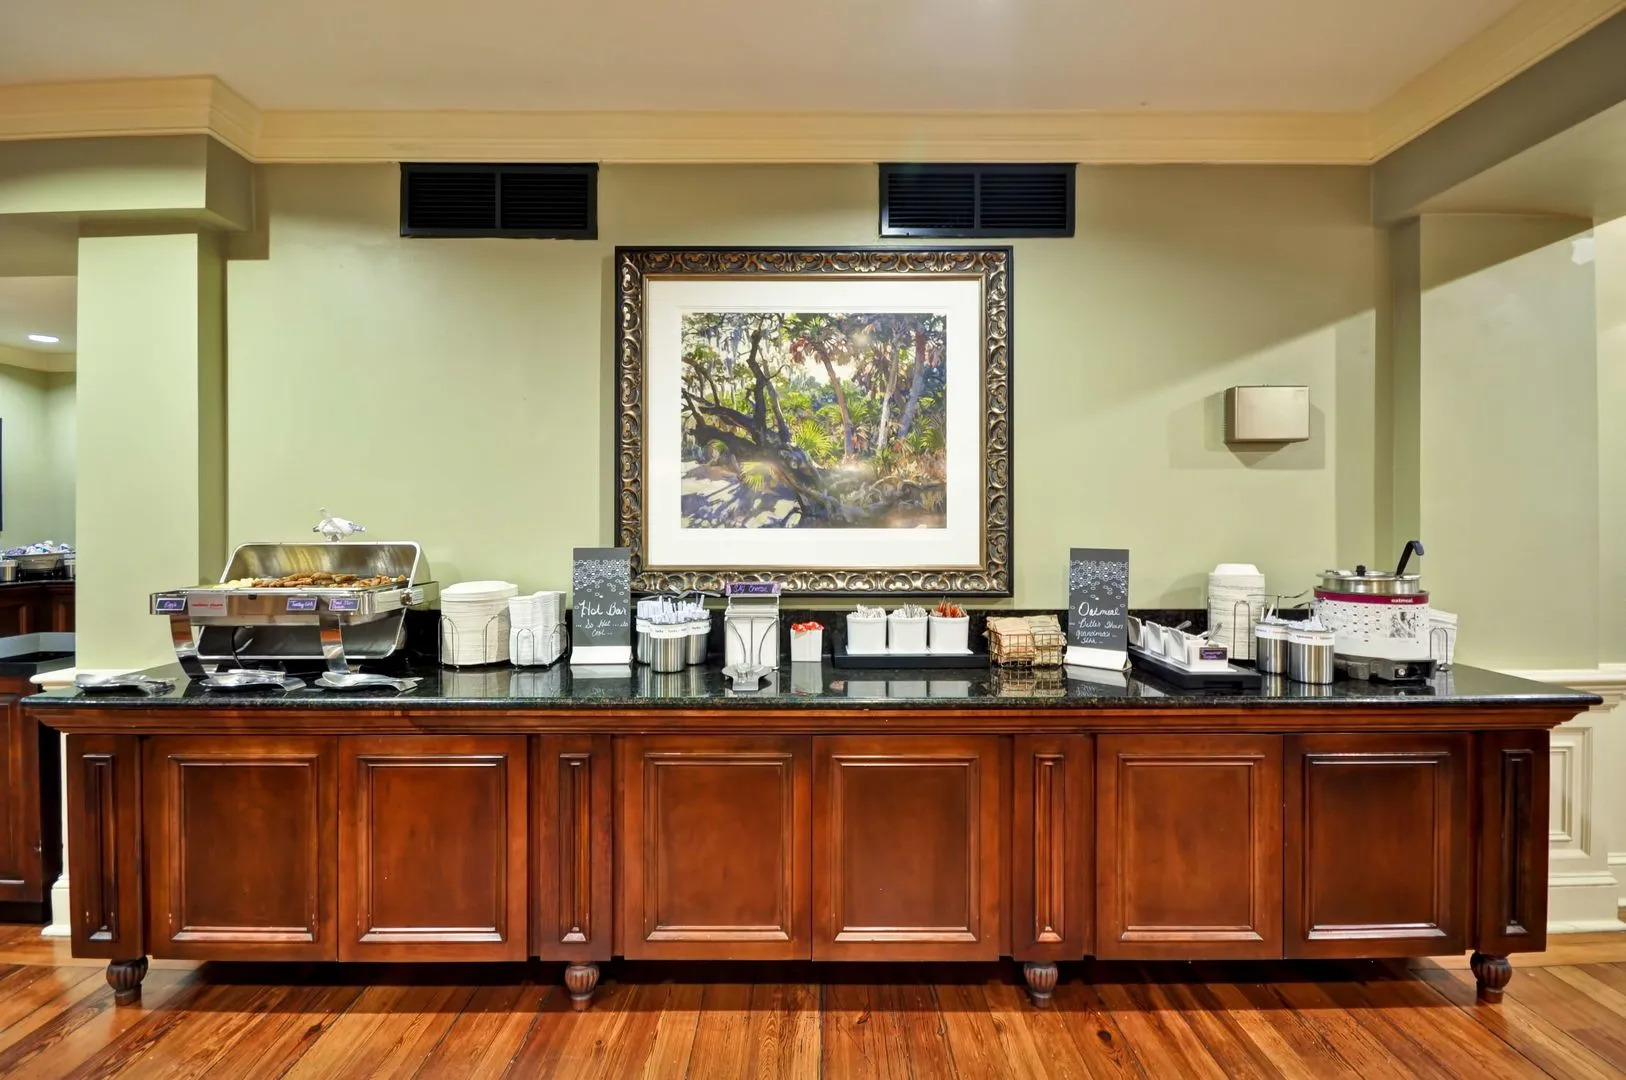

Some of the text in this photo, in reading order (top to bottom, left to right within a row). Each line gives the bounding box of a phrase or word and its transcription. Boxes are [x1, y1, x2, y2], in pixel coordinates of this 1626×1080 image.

[578, 599, 627, 618] Hot Bar
[1078, 602, 1120, 616] Oatmeal
